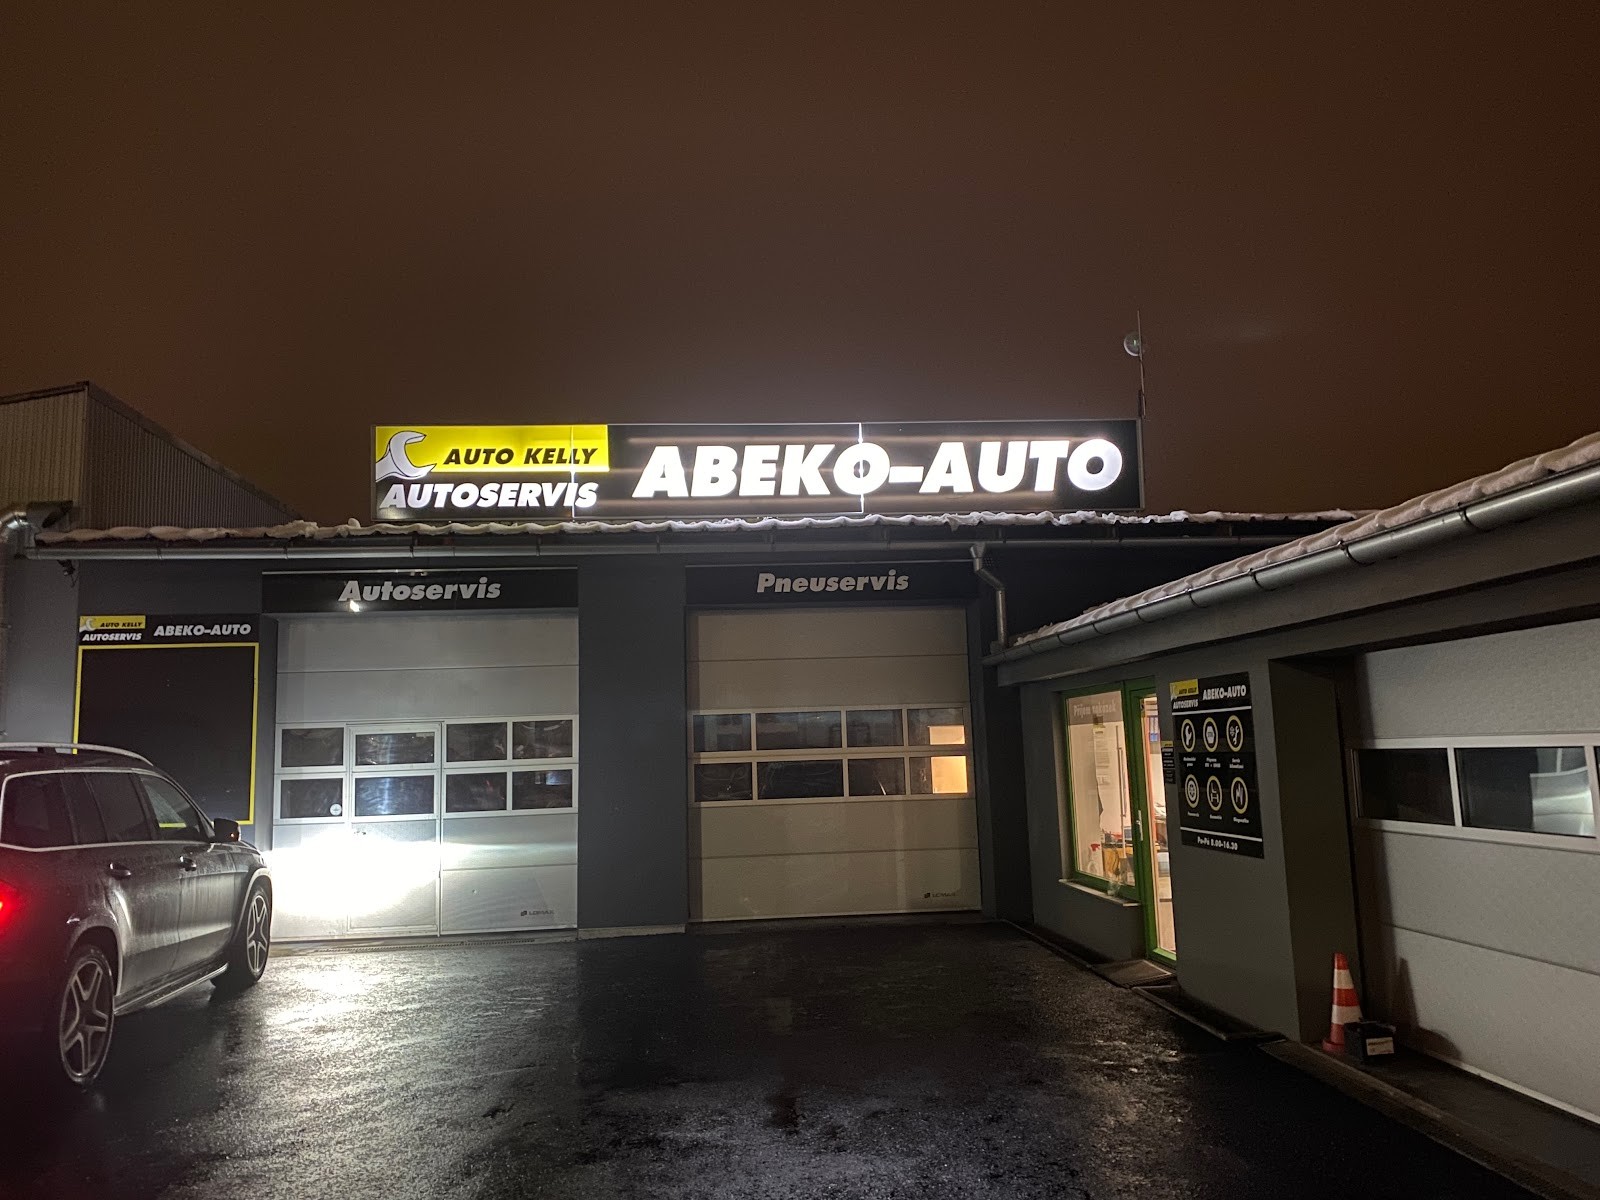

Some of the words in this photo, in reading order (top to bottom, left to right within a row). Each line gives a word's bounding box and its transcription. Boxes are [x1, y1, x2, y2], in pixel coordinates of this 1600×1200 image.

[444, 448, 514, 465] AUTO
[524, 447, 598, 465] KELLY
[632, 438, 1123, 498] ABEKO-AUTO
[379, 482, 599, 509] AUTOSERVIS
[338, 577, 501, 601] Autoservis
[757, 569, 909, 594] Pneuservis
[82, 633, 142, 641] AUTOSERVIS
[153, 623, 251, 636] ABEKO-AUTO
[1203, 685, 1247, 700] ABEKO-AUTO
[1173, 699, 1198, 709] AUTOSERVIS
